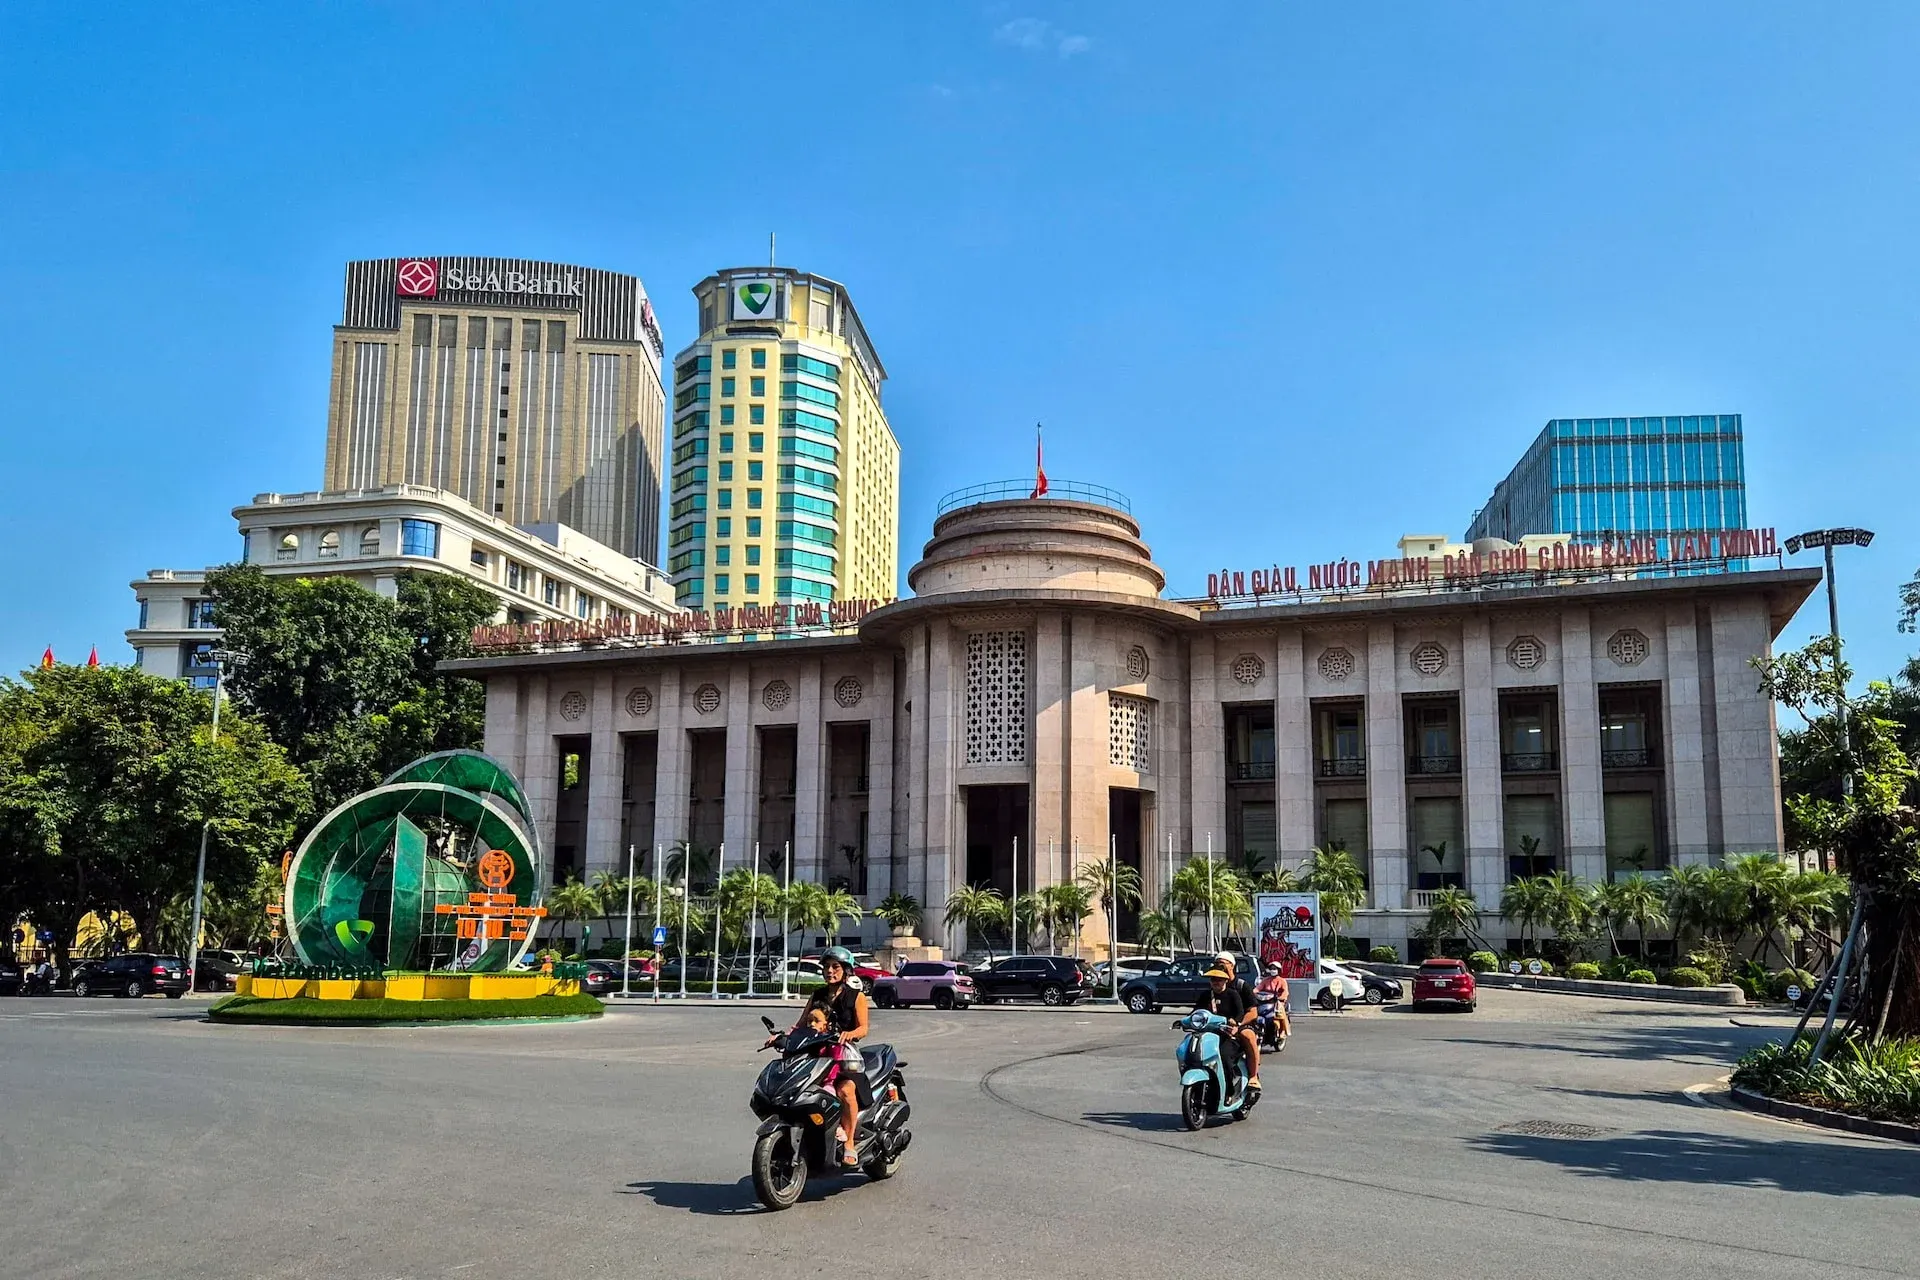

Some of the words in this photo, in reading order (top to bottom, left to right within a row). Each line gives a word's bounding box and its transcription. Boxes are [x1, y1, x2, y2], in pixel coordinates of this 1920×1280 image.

[446, 268, 582, 297] SeABank
[1207, 568, 1245, 598] DÂN
[1309, 556, 1361, 590] NƯỚC
[1443, 549, 1482, 580] DÂN
[1538, 540, 1595, 571] CÔNG
[1718, 527, 1776, 558] MINH
